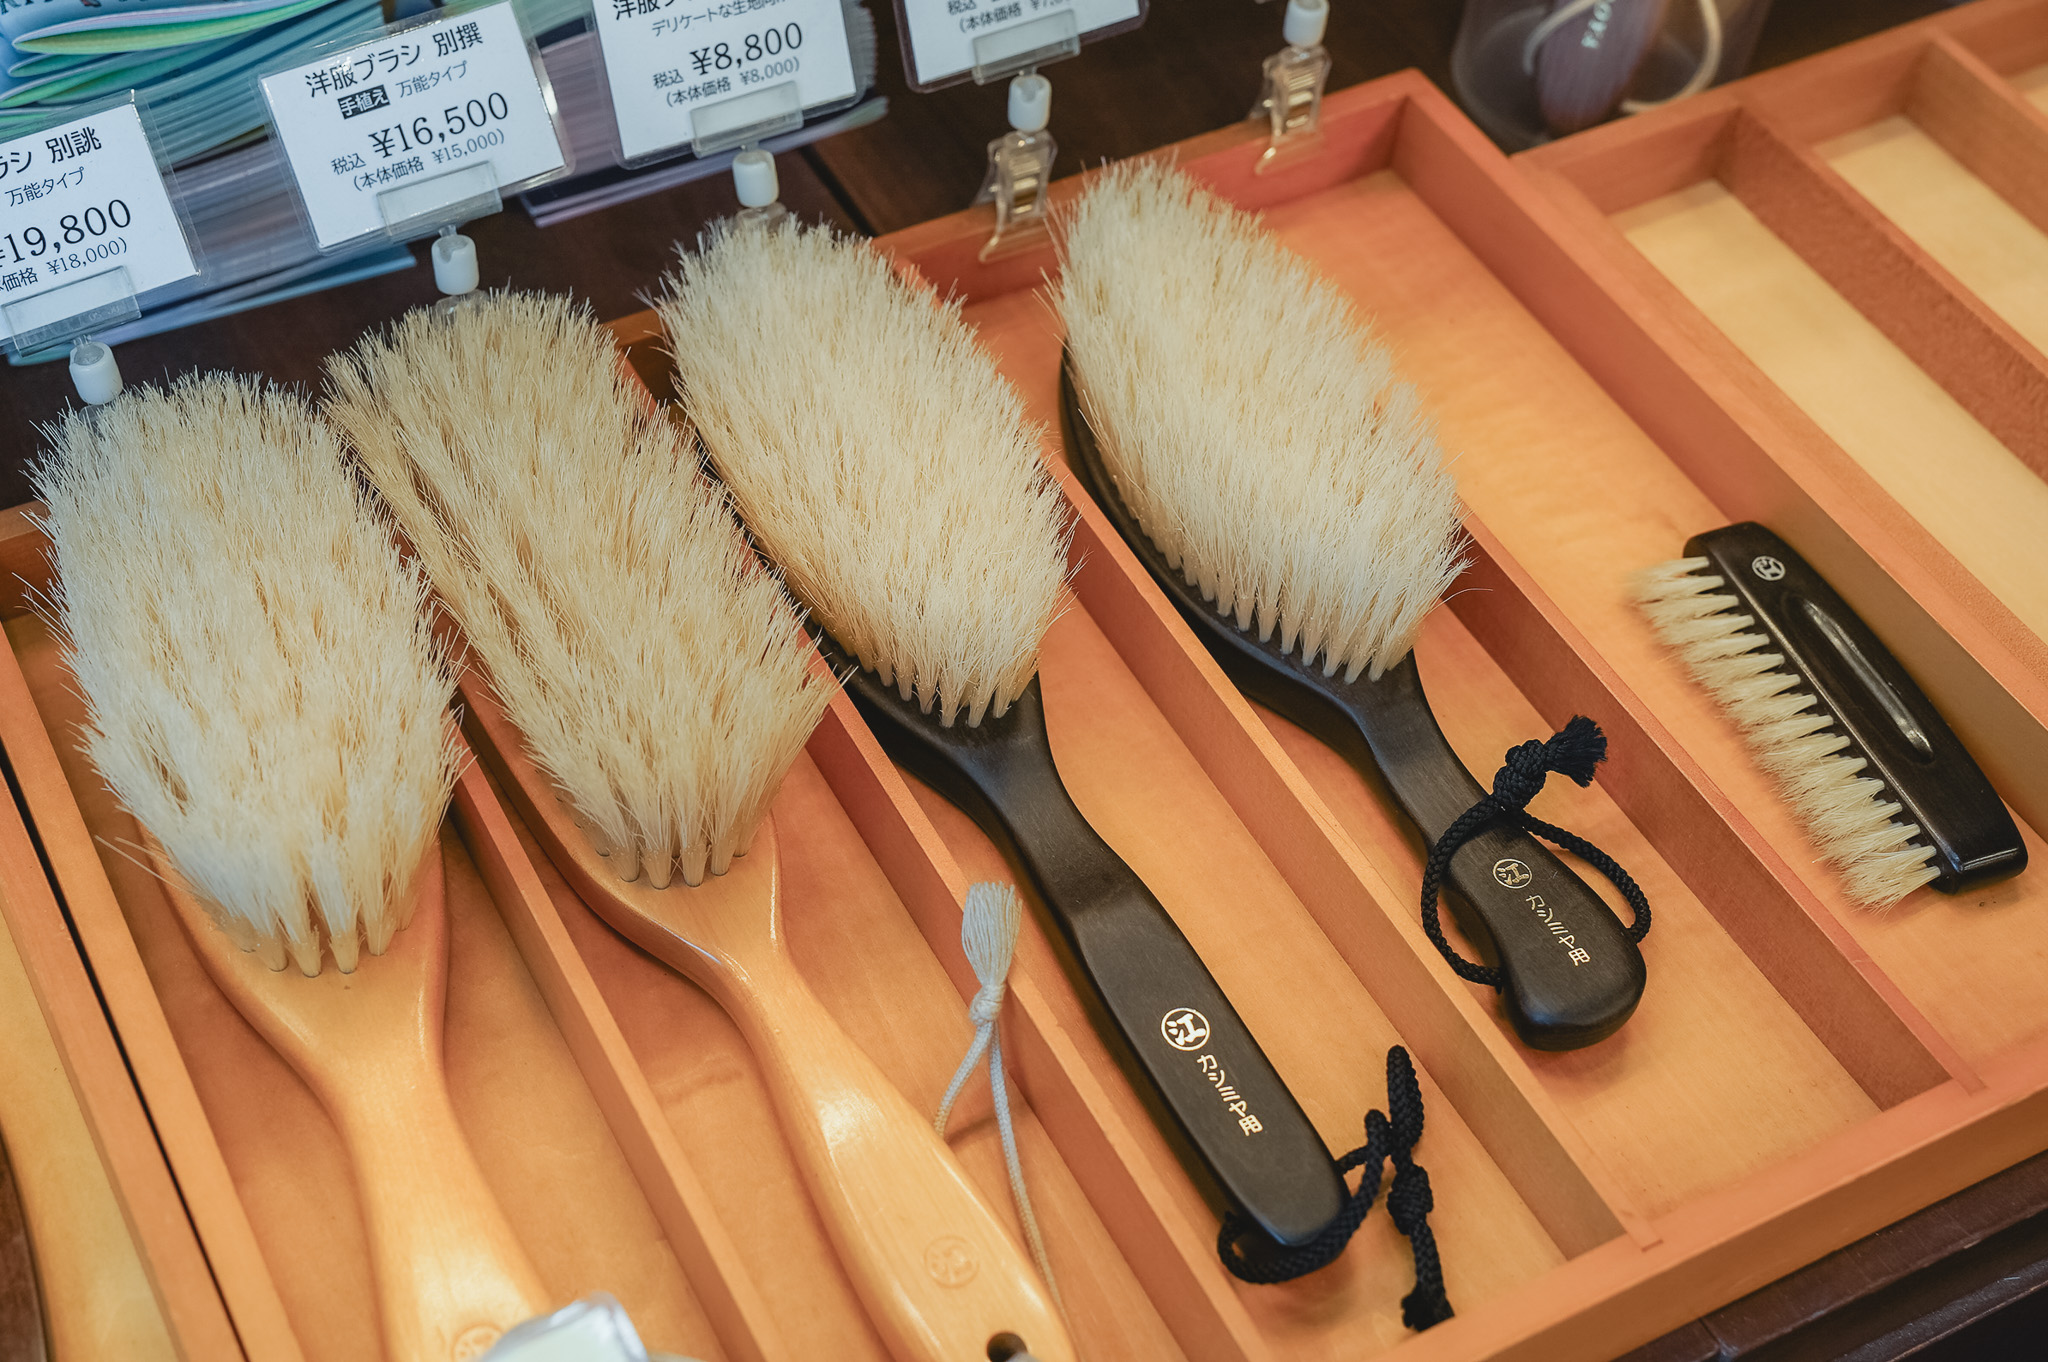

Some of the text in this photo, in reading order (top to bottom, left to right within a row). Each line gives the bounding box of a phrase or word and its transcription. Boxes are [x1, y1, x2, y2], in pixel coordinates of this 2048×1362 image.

[305, 21, 484, 98] 洋服ブラシ 別撰
[653, 22, 803, 90] 税込 ¥8,800
[666, 56, 801, 107] (本体価格 ¥8,000)
[338, 60, 468, 118] 手植え 万能タイプ
[331, 92, 508, 176] 税込 ¥16,500
[353, 128, 506, 192] (本体価格 ¥15,000)
[4, 165, 84, 207] 万能タイプ
[0, 236, 127, 292] 価格 ¥18,000)
[1163, 1011, 1208, 1047] 江
